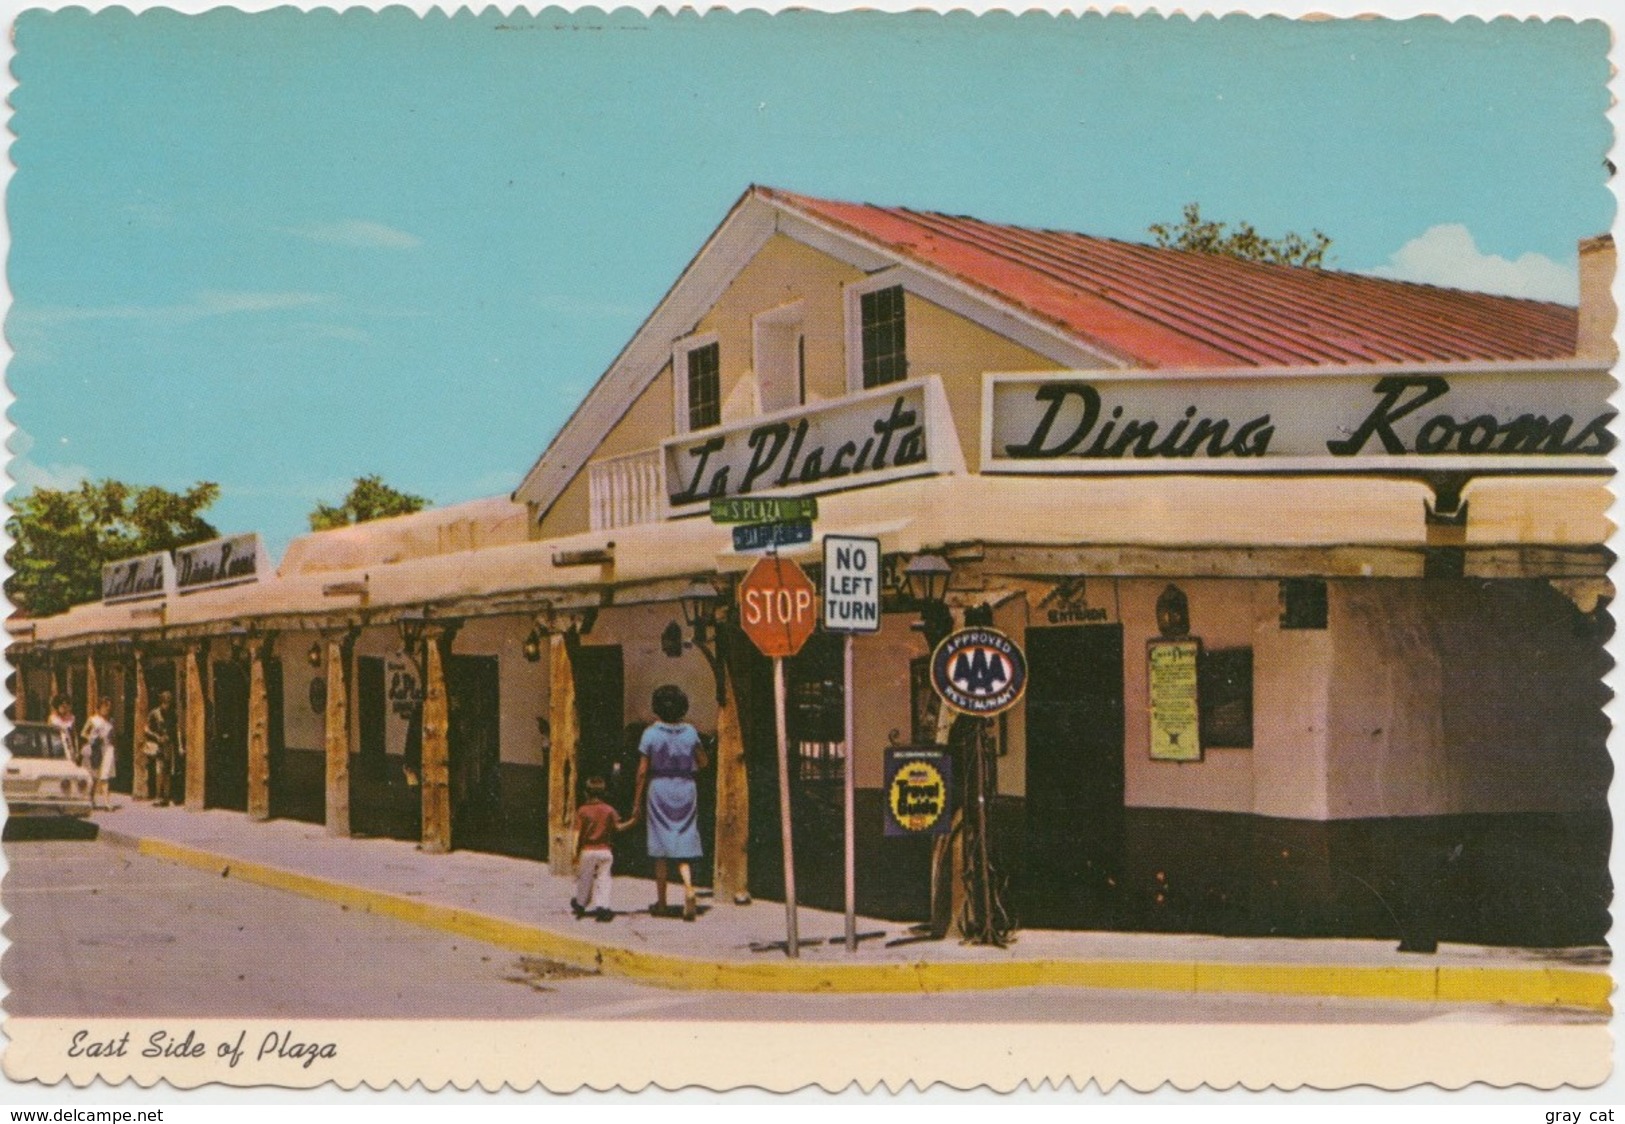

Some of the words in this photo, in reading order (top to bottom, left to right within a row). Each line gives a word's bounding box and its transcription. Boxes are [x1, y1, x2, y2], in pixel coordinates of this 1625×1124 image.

[1326, 375, 1618, 456] Rooms
[737, 396, 928, 493] Placita
[743, 499, 781, 520] PLAZA
[836, 548, 867, 571] NO
[830, 577, 873, 595] LEFT
[745, 589, 811, 625] STOP
[828, 601, 876, 620] TURN
[946, 633, 1012, 655] APPROVED
[953, 648, 1008, 693] AAA
